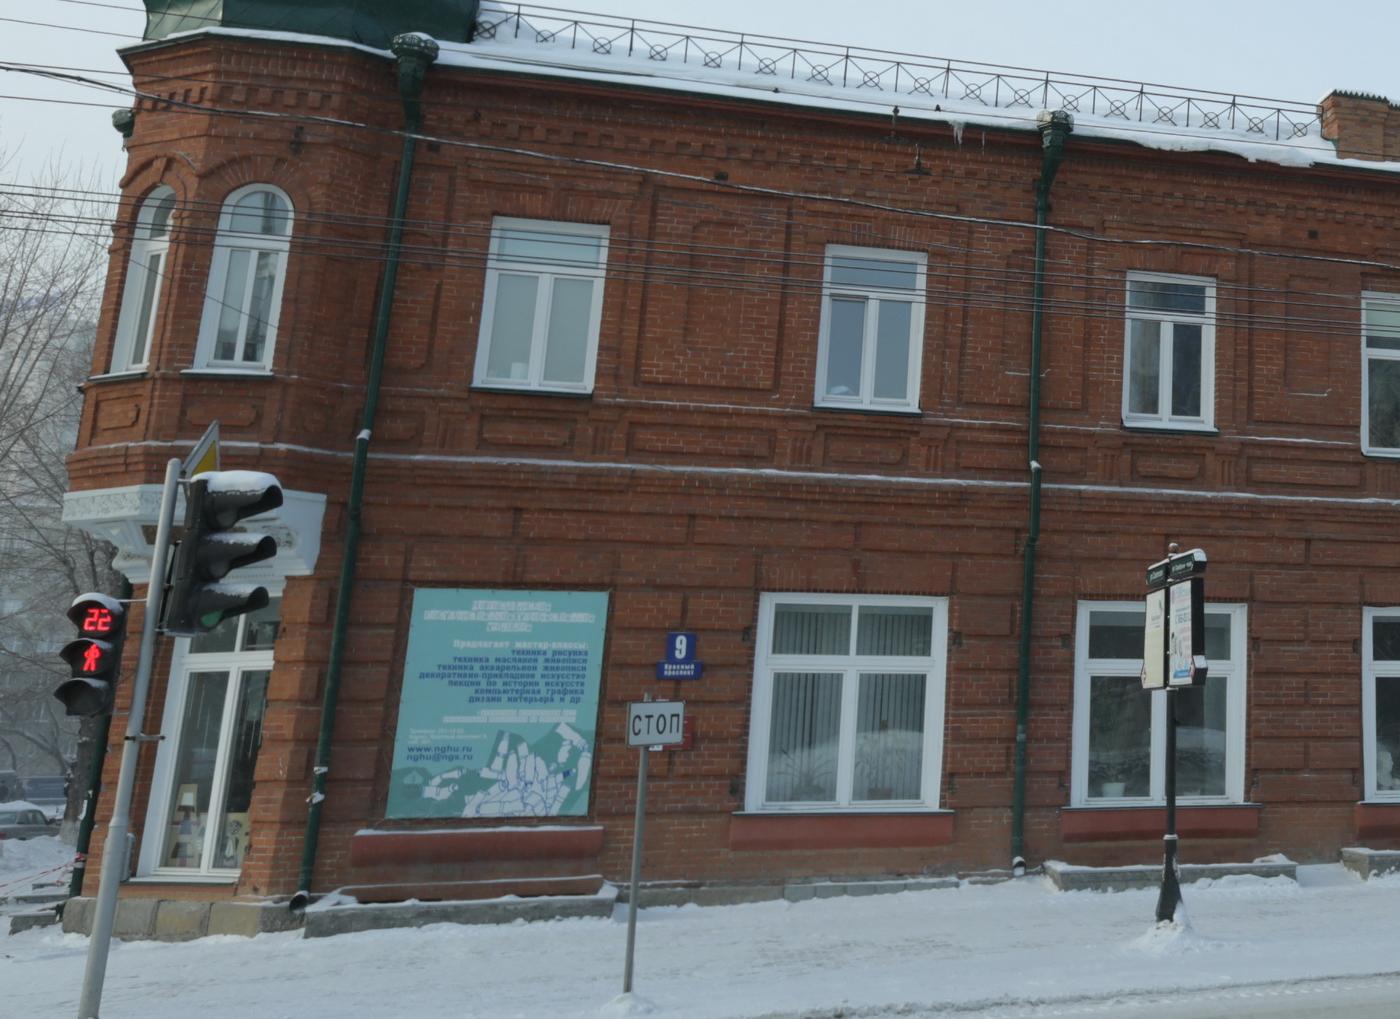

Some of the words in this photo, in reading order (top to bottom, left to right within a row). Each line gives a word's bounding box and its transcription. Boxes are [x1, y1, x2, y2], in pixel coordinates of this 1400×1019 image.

[83, 607, 112, 631] 22
[674, 634, 687, 659] 9
[664, 663, 695, 671] Красный
[632, 713, 680, 736] СТОП
